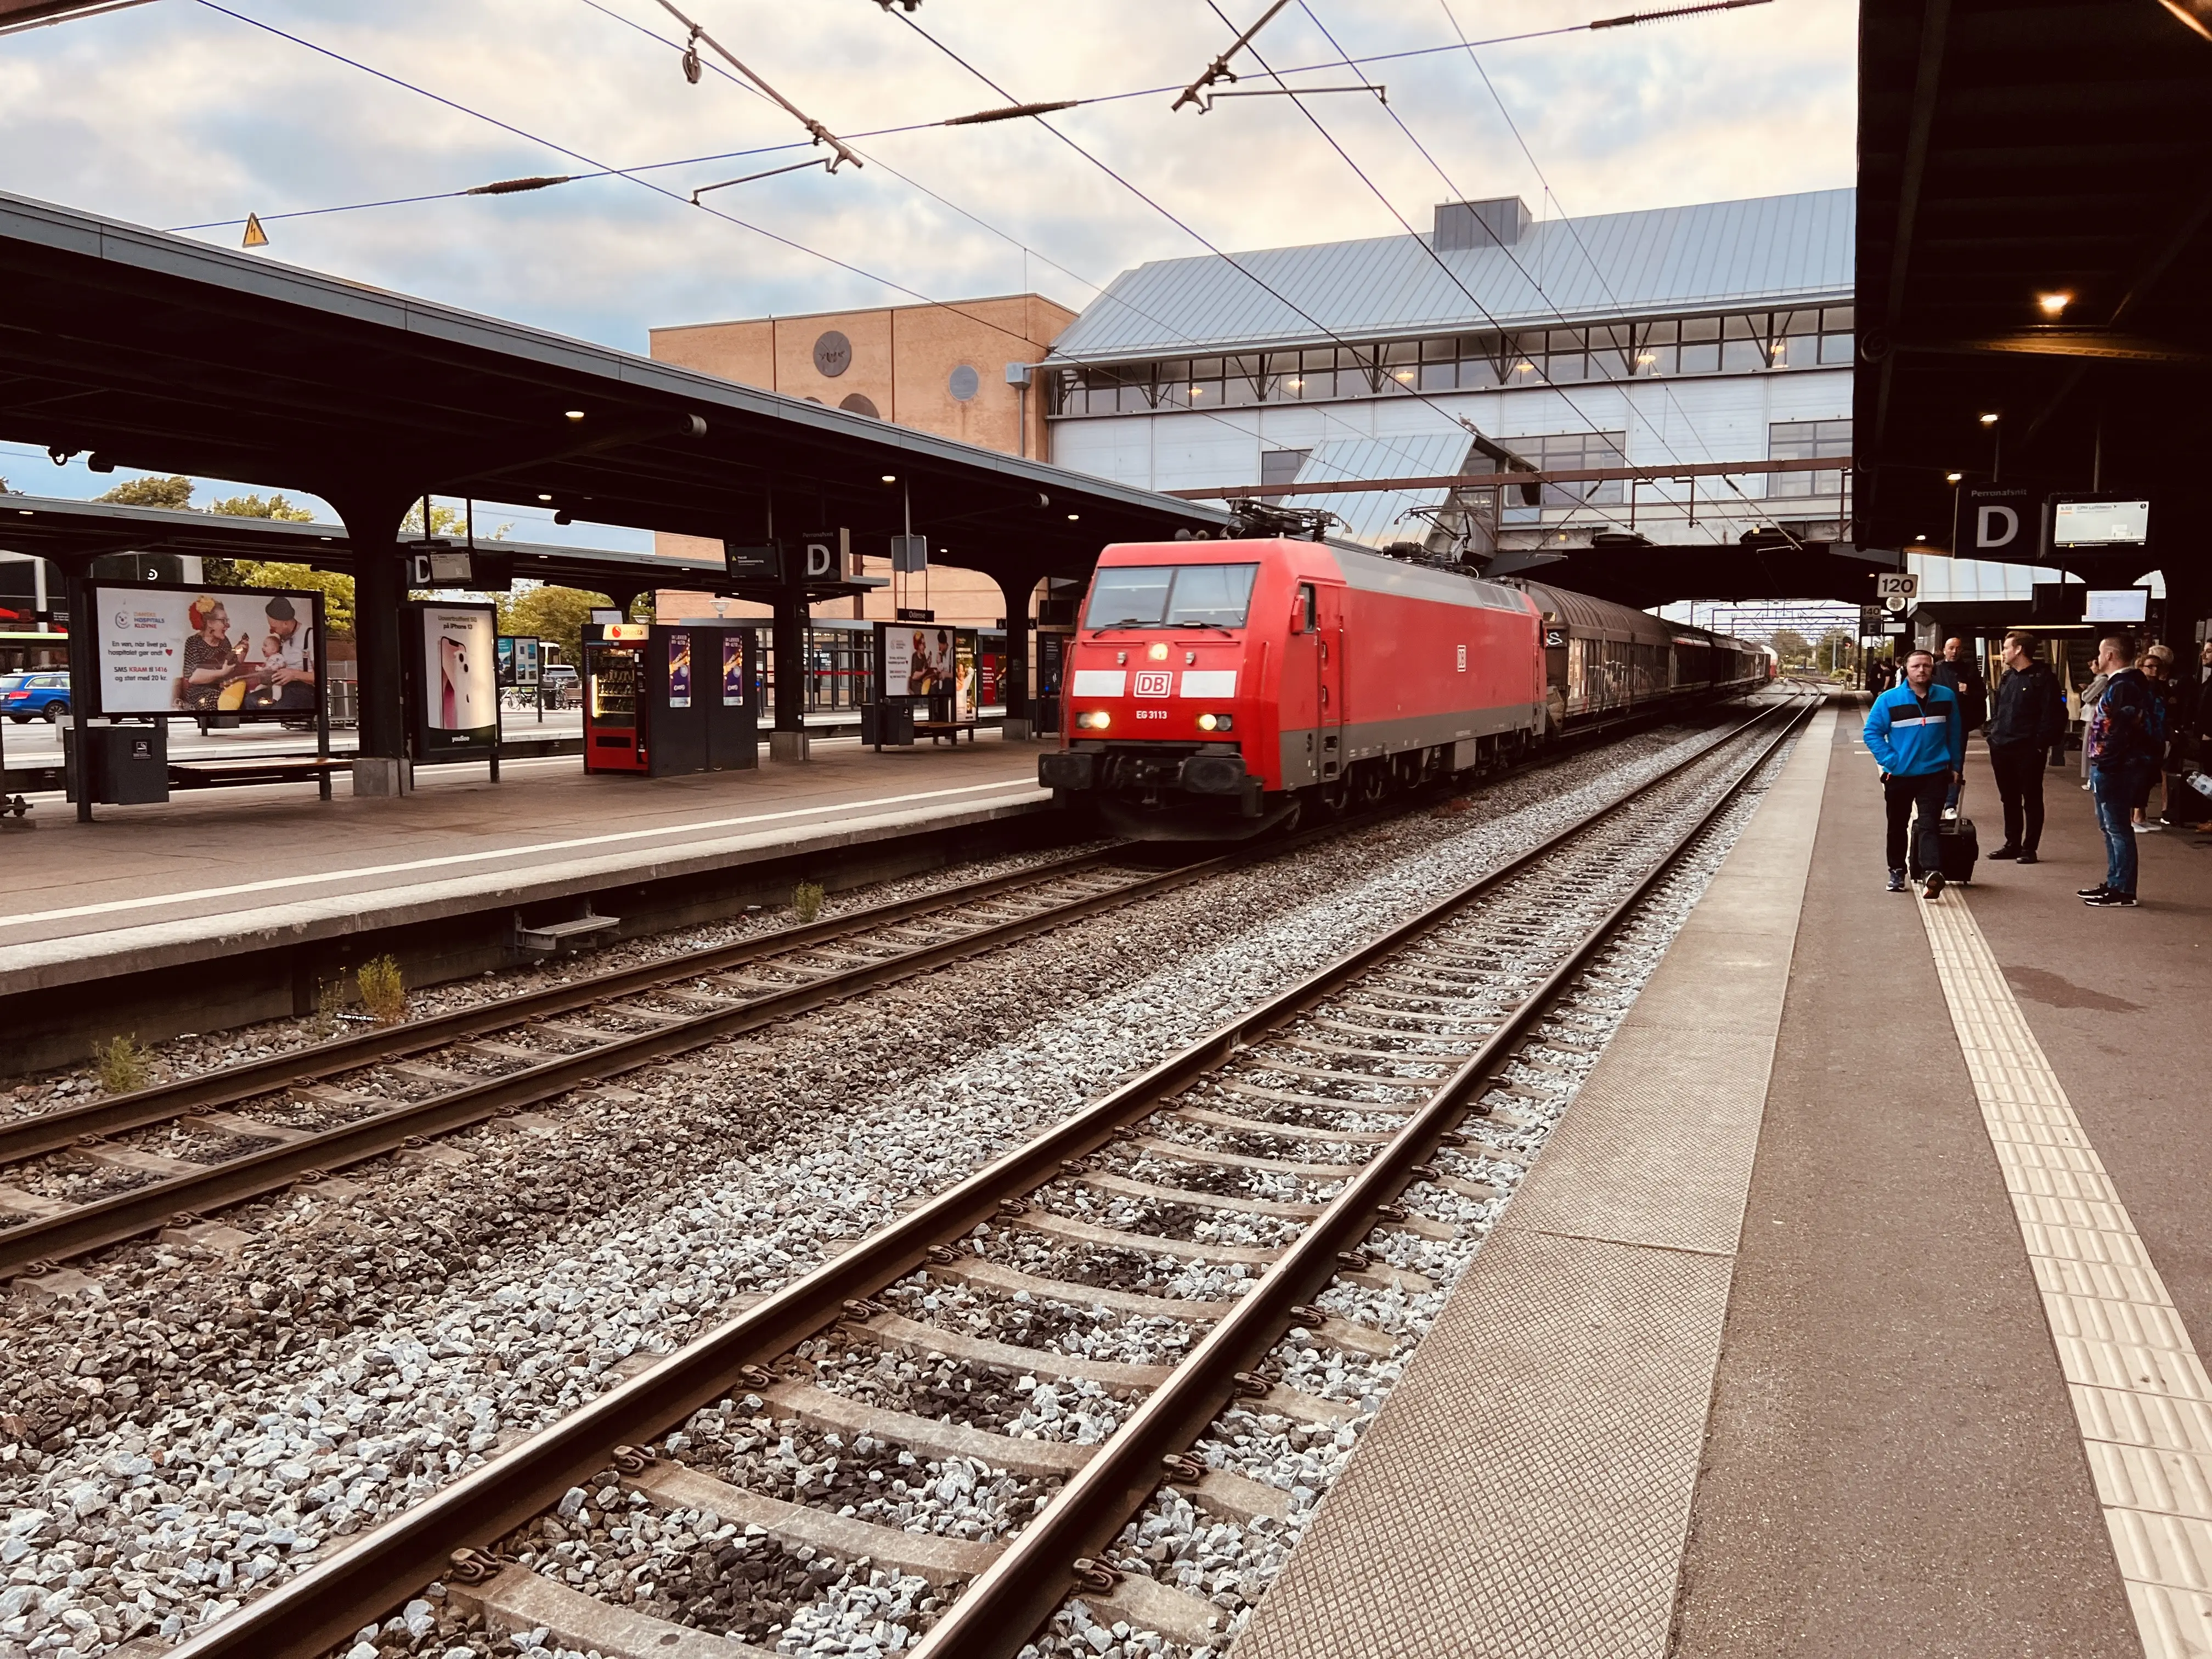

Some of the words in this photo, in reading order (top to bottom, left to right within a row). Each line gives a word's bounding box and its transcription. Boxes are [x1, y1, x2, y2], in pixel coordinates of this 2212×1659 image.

[1971, 489, 2027, 497] Perronafsnit
[1977, 505, 2019, 548] D
[808, 544, 830, 575] D
[415, 555, 430, 583] D
[1882, 578, 1914, 593] 120
[909, 611, 926, 619] Odense
[1867, 623, 1876, 634] E
[1141, 677, 1164, 691] DB
[1136, 710, 1148, 719] EG
[1148, 710, 1167, 719] 3113
